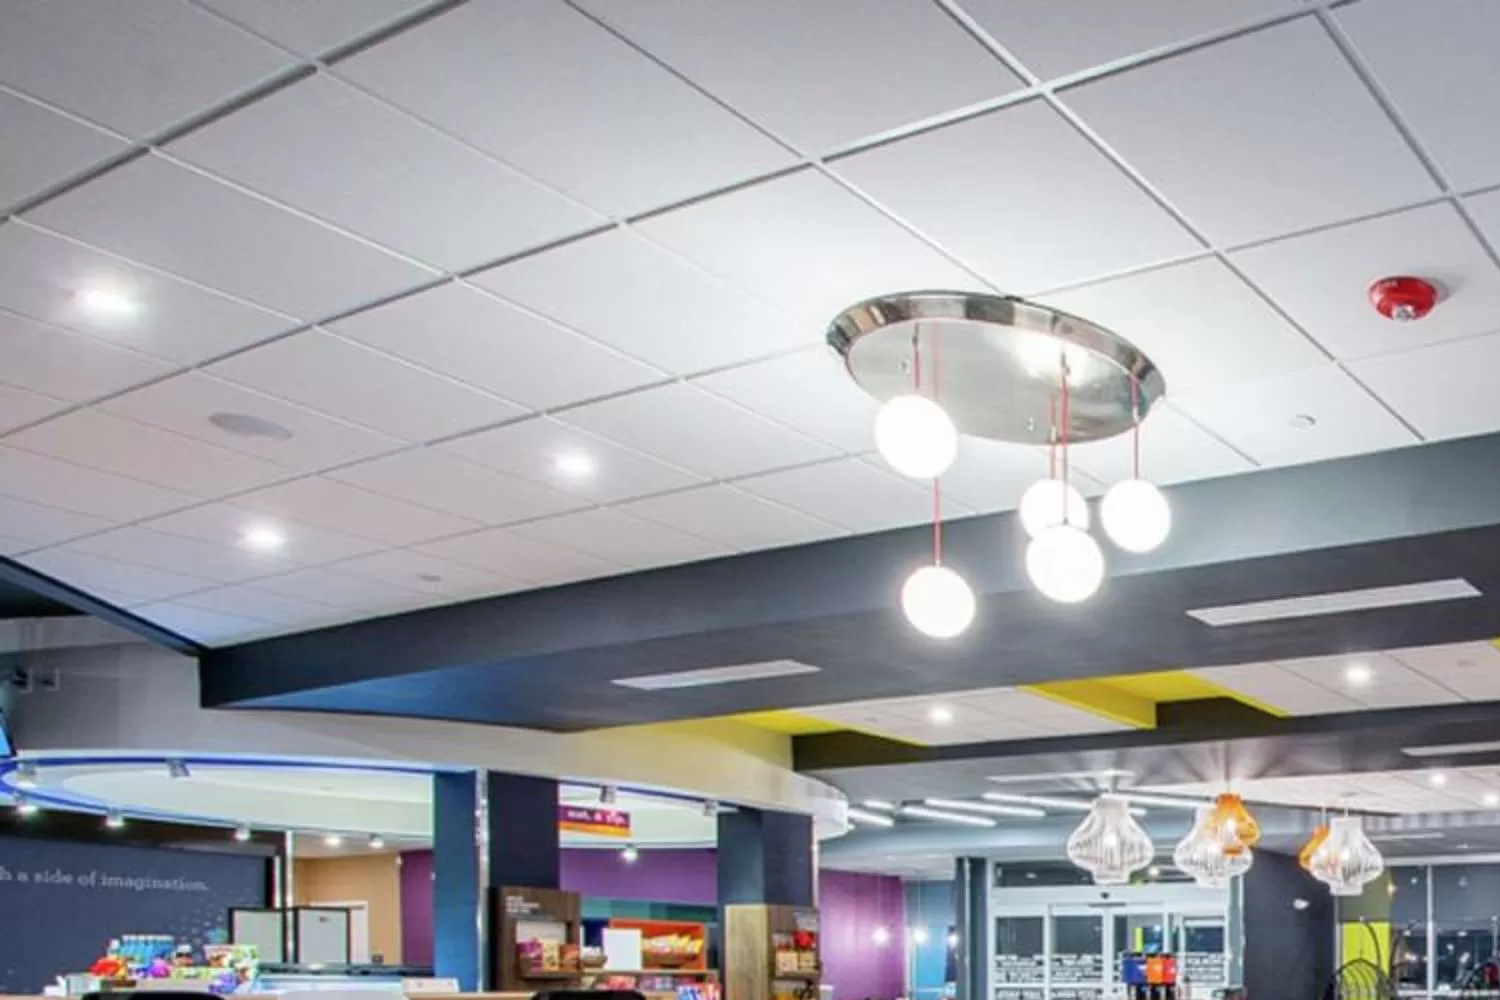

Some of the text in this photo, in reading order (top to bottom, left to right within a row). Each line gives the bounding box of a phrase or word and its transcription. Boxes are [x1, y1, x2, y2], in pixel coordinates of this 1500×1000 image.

[17, 871, 29, 883] a
[34, 868, 74, 885] side
[77, 870, 97, 888] of
